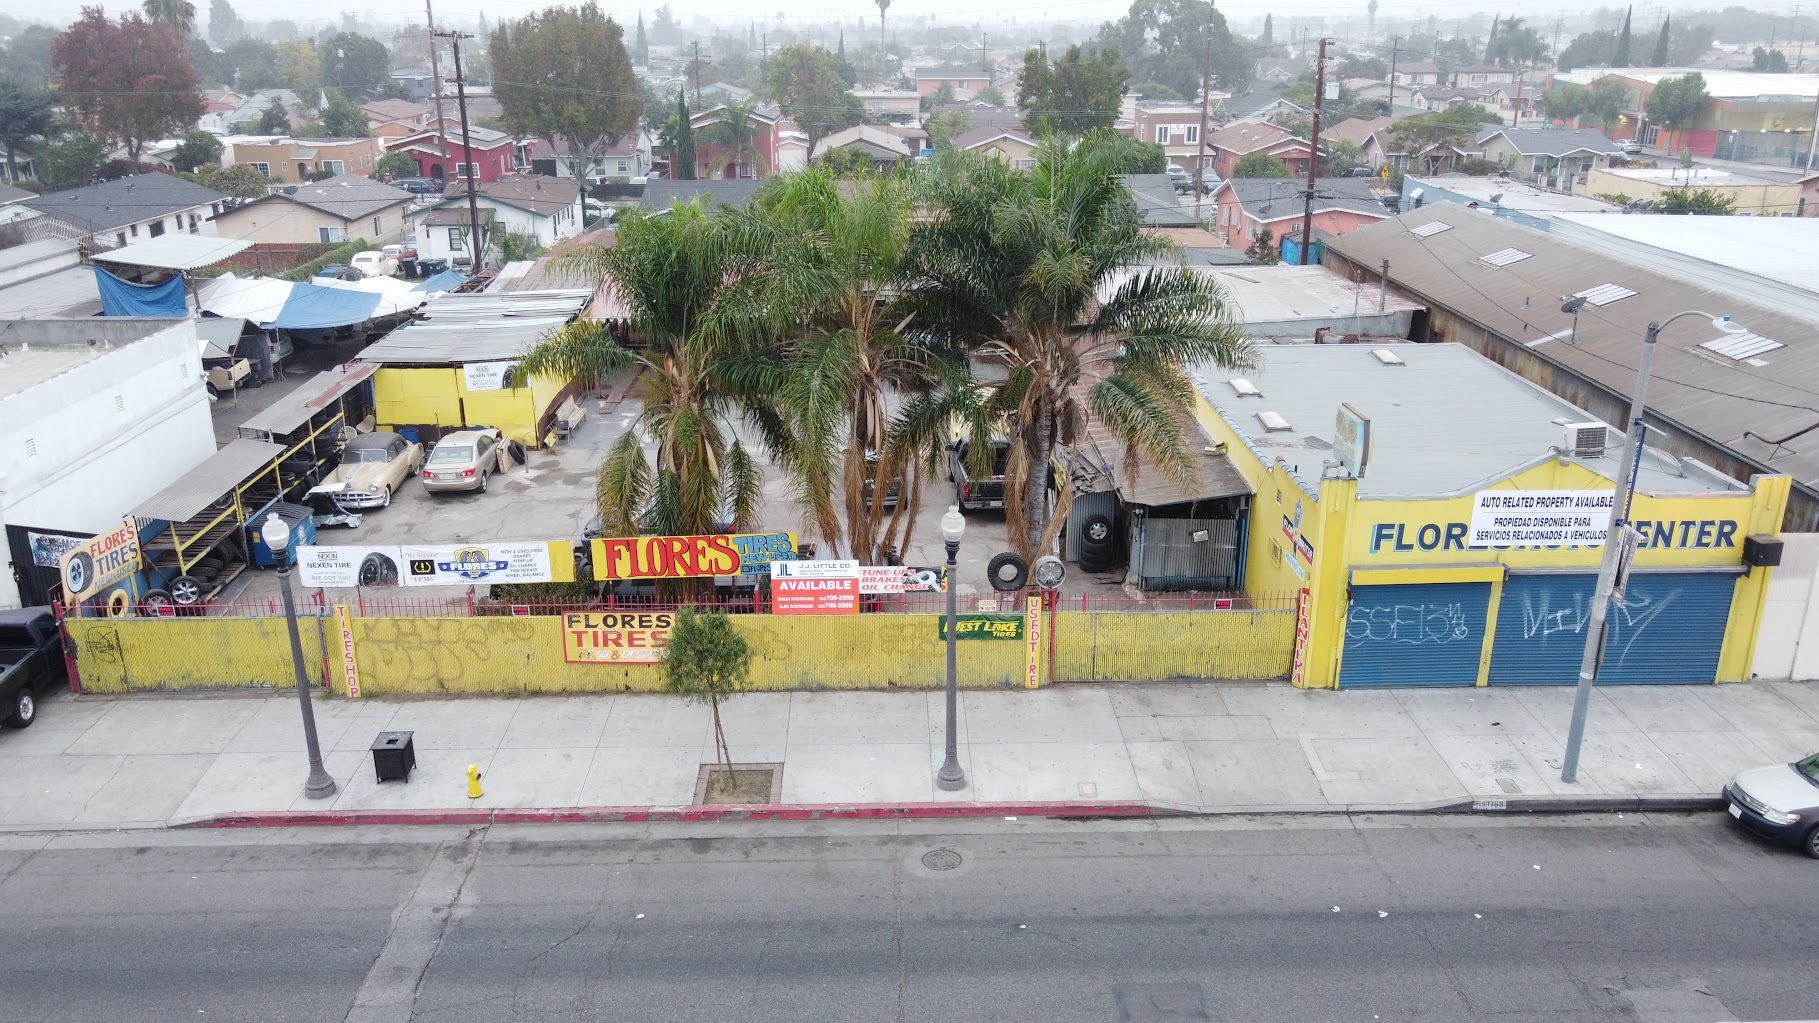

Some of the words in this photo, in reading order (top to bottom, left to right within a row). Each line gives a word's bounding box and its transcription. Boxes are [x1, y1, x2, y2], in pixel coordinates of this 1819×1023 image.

[1481, 497, 1501, 508] AUTO
[1502, 497, 1534, 507] RELATED
[1535, 497, 1574, 508] PROPERTY
[1574, 496, 1614, 508] AVAILABLE
[1494, 517, 1532, 527] PROPIEDAD
[1532, 517, 1572, 527] DISPONIBLE
[1573, 518, 1591, 527] PARA
[90, 525, 135, 559] FLORES
[1476, 531, 1511, 541] SERVICIOS
[1511, 531, 1562, 541] RELACIONADOS
[1564, 531, 1568, 540] A
[1570, 531, 1607, 540] VEHICULOS
[1627, 520, 1739, 550] ENTER
[732, 532, 793, 555] TIRES
[96, 542, 139, 575] TIRES
[602, 536, 741, 579] FLORES
[450, 561, 497, 571] FLORES
[780, 581, 852, 591] AVAILABLE
[568, 614, 672, 629] FLORES
[983, 620, 1020, 633] LAKE
[571, 630, 670, 648] TIRES
